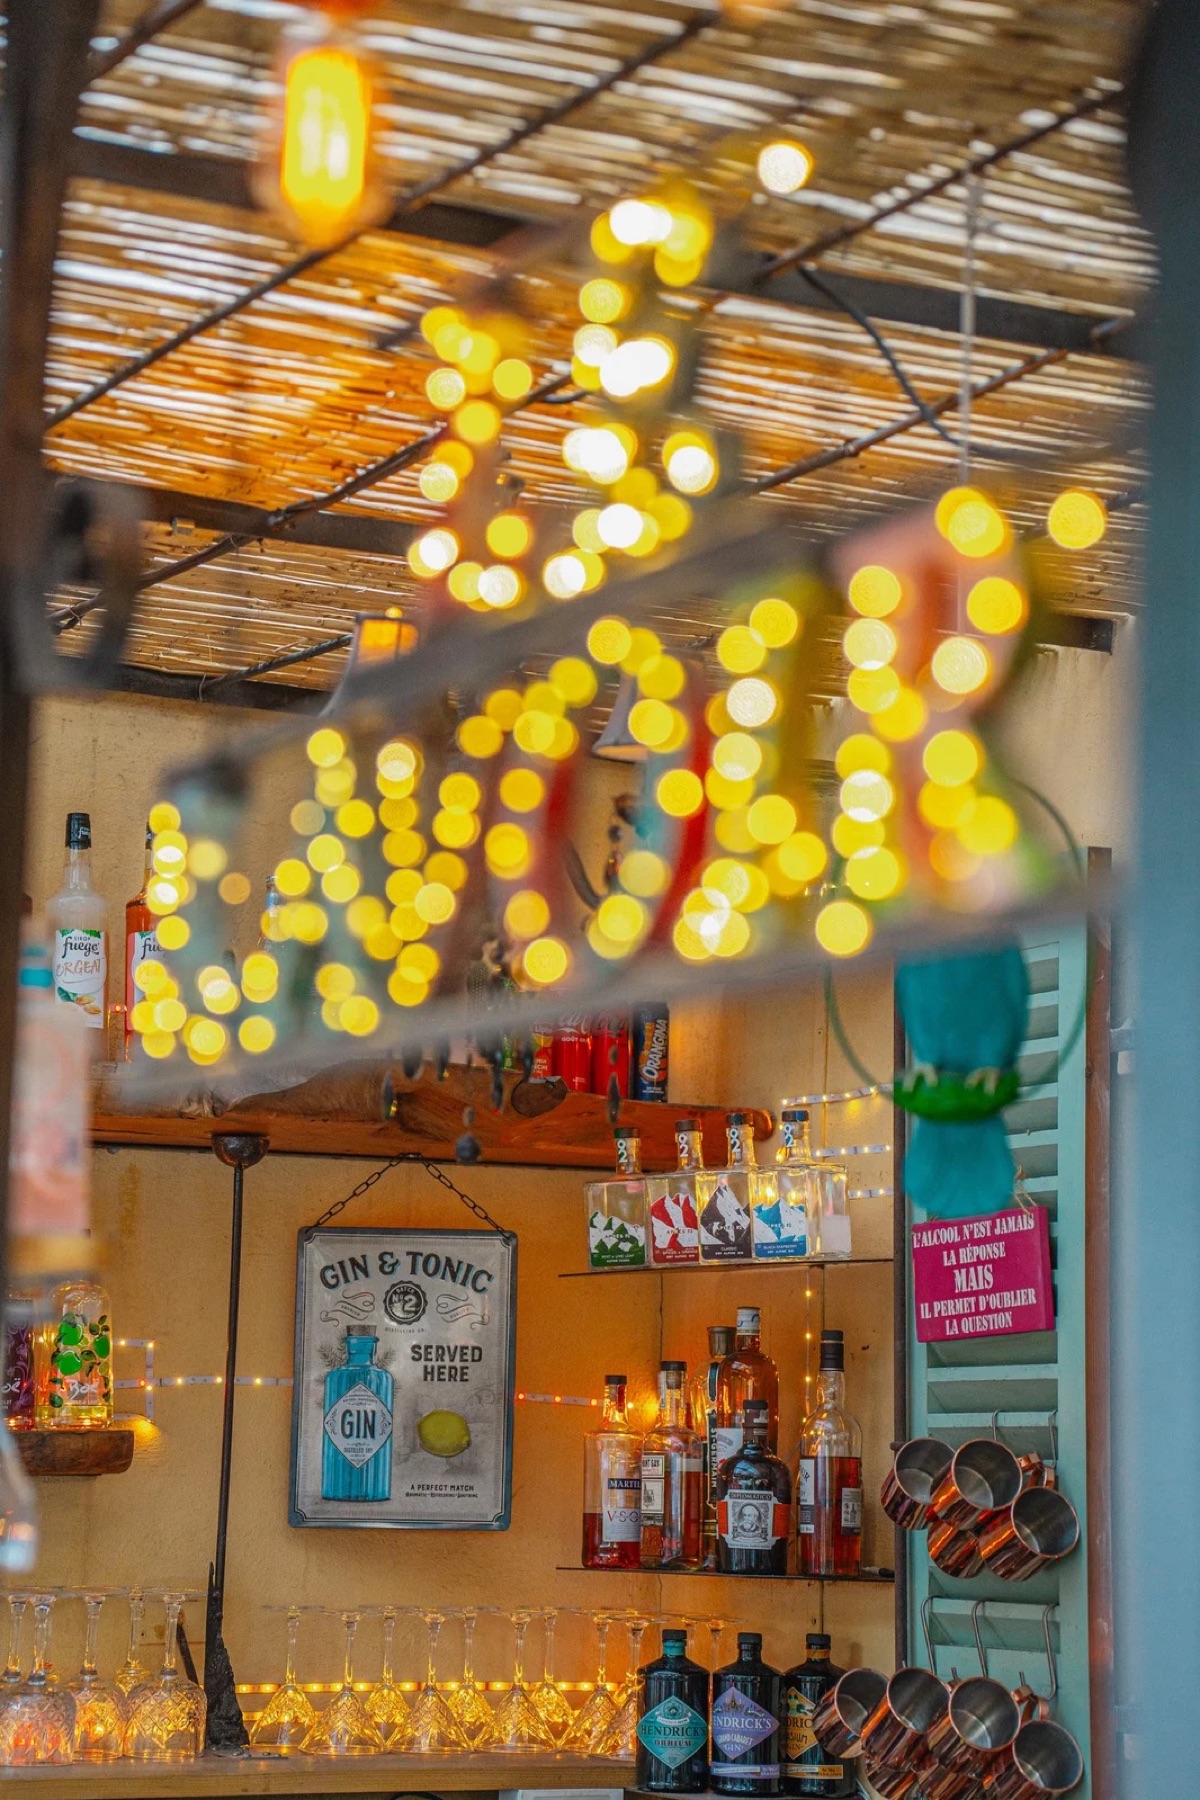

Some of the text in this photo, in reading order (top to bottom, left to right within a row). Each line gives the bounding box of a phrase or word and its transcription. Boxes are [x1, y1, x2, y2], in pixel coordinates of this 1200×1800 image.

[55, 957, 105, 977] ORGEAT
[641, 1019, 668, 1079] ORANGINA
[913, 1213, 1035, 1248] L'ALCOOL N'EST JAMAIS
[943, 1241, 1006, 1266] LA RÉPONSE
[319, 1251, 494, 1293] GIN & TONIC
[953, 1264, 994, 1293] MAIS
[920, 1288, 1037, 1319] IL PERMET D'OUBLIER
[945, 1311, 1013, 1336] LA QUESTION
[410, 1344, 483, 1364] SERVED
[422, 1365, 470, 1383] HERE
[340, 1408, 376, 1440] GIN
[417, 1484, 448, 1492] PERFECT
[449, 1484, 475, 1492] MATCH
[713, 1715, 772, 1729] ENDRICK'S
[724, 1743, 741, 1751] GIN
